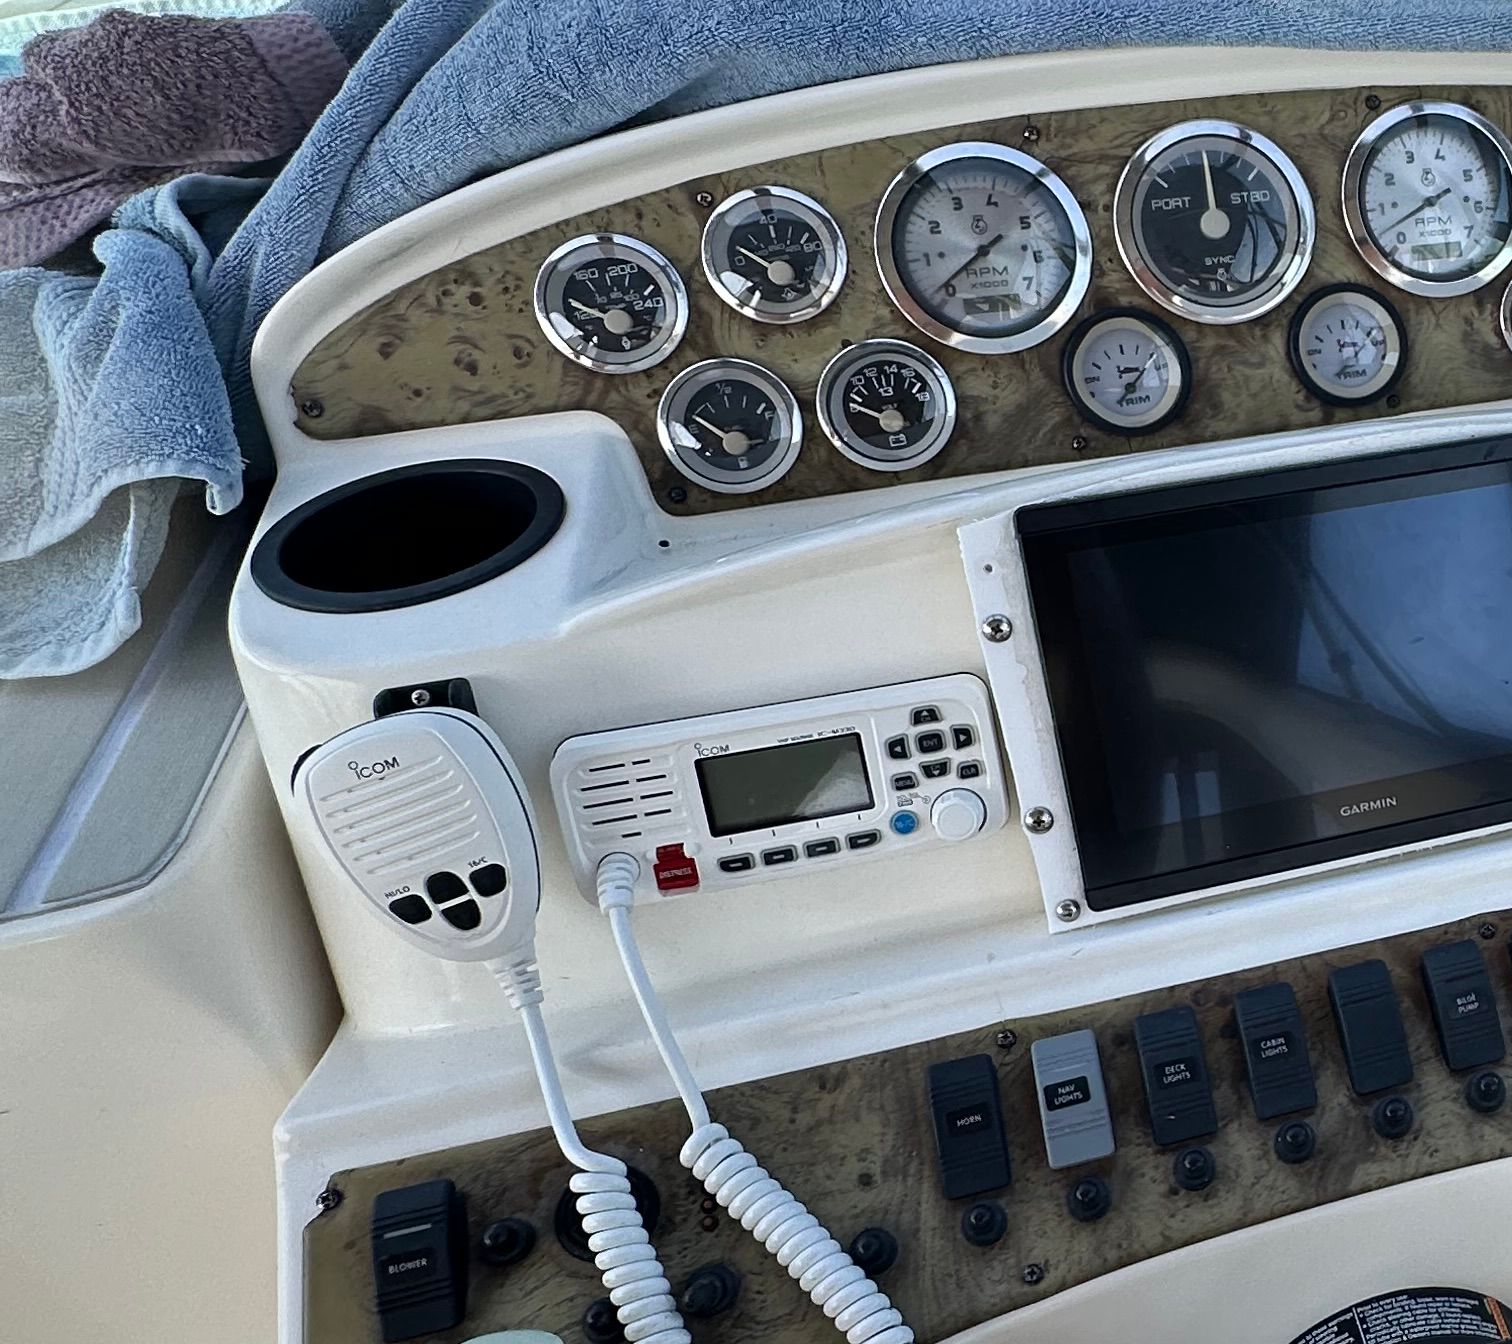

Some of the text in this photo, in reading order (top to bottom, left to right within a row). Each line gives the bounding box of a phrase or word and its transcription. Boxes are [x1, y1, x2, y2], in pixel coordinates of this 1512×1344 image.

[1405, 150, 1415, 164] 3
[1434, 148, 1446, 161] 4
[1384, 173, 1396, 186] 2
[1462, 169, 1473, 182] 5
[951, 196, 964, 211] 3
[986, 193, 999, 207] 4
[1151, 196, 1191, 211] PORT
[1230, 190, 1271, 204] STBD
[1474, 200, 1484, 214] 6
[760, 214, 778, 224] 40
[1019, 215, 1031, 230] 5
[1415, 215, 1453, 227] RPM
[928, 220, 942, 235] 2
[1463, 224, 1474, 239] 7
[1396, 231, 1407, 244] 0
[1204, 255, 1236, 266] SYNC
[573, 267, 599, 280] 160
[607, 263, 638, 276] 200
[965, 265, 1010, 279] RPM
[944, 283, 957, 297] 0
[1022, 276, 1034, 291] 7
[633, 297, 664, 311] 240
[883, 364, 898, 374] 14
[1340, 796, 1397, 816] GARMIN
[1260, 1036, 1286, 1049] CABIN
[1261, 1045, 1289, 1058] LIGHTS
[1164, 1063, 1187, 1075] DECK
[1162, 1072, 1191, 1084] LIGHTS
[1057, 1084, 1076, 1095] NAV
[1054, 1091, 1084, 1106] LIGHTS
[388, 1258, 428, 1274] BLOWER
